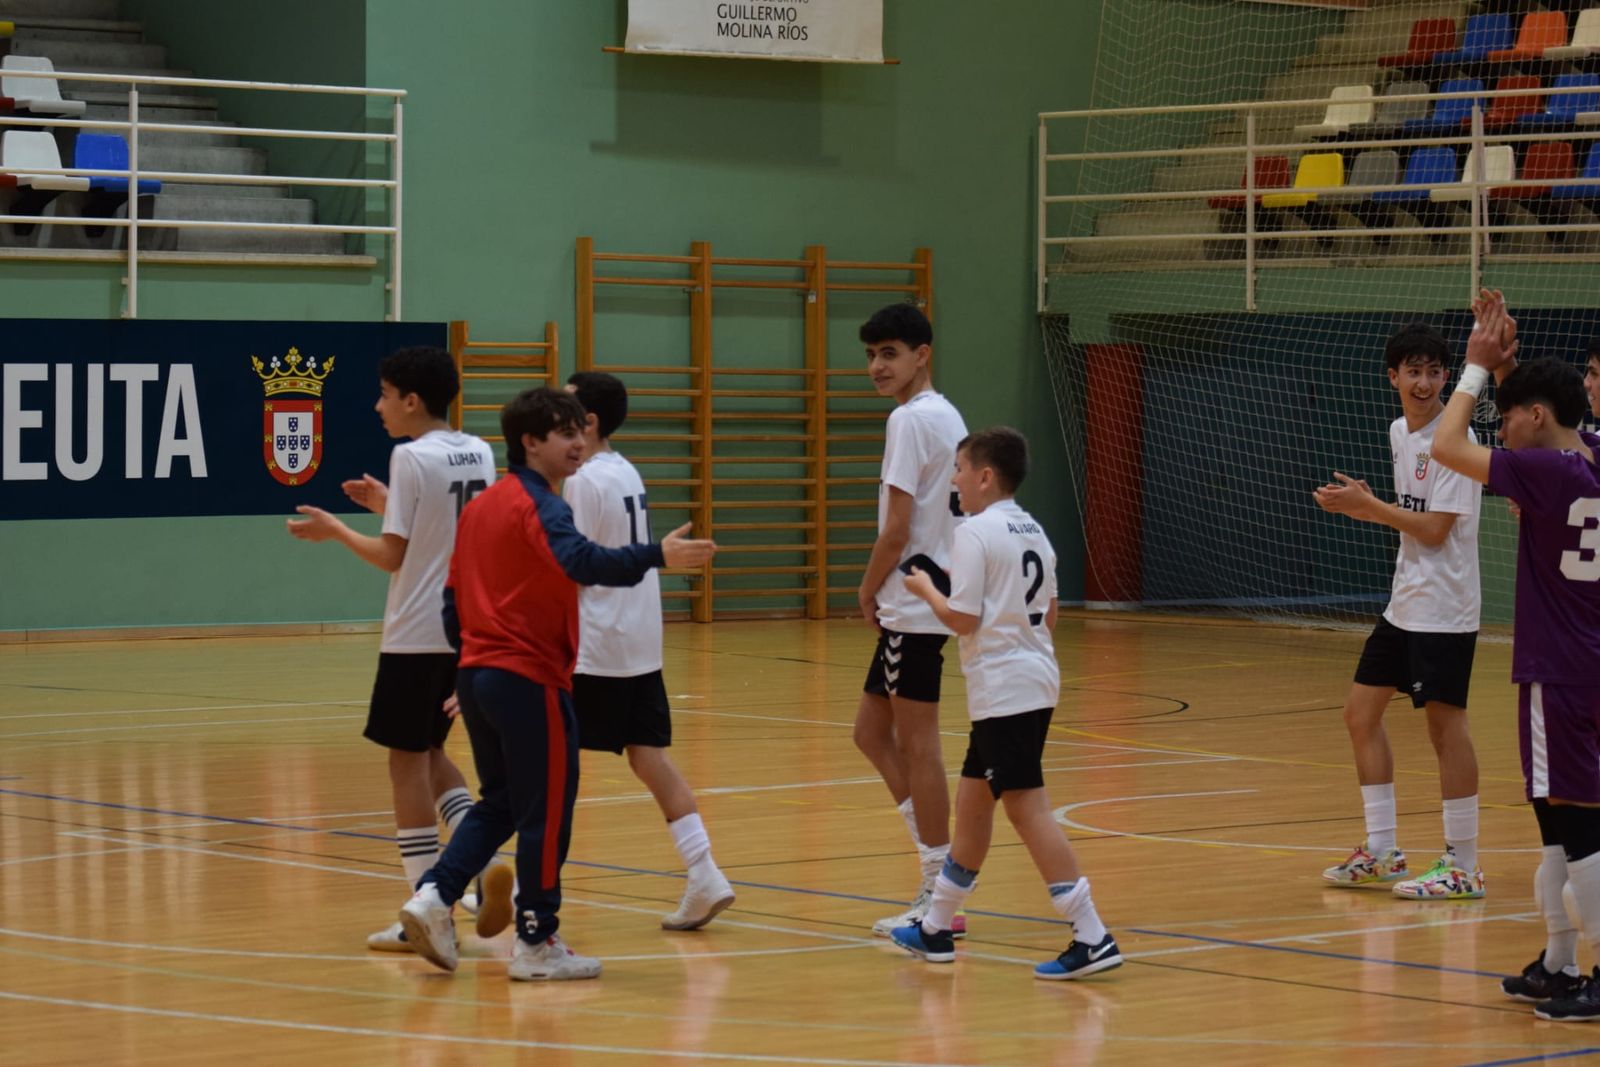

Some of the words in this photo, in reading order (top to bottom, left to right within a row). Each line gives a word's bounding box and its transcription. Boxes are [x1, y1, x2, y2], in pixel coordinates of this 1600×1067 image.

[717, 3, 797, 22] GUILLERMO
[717, 22, 773, 39] MOLINA
[778, 21, 808, 41] RÍOS
[3, 362, 208, 481] EUTA
[447, 453, 482, 466] LUHAY
[1022, 550, 1044, 626] 2
